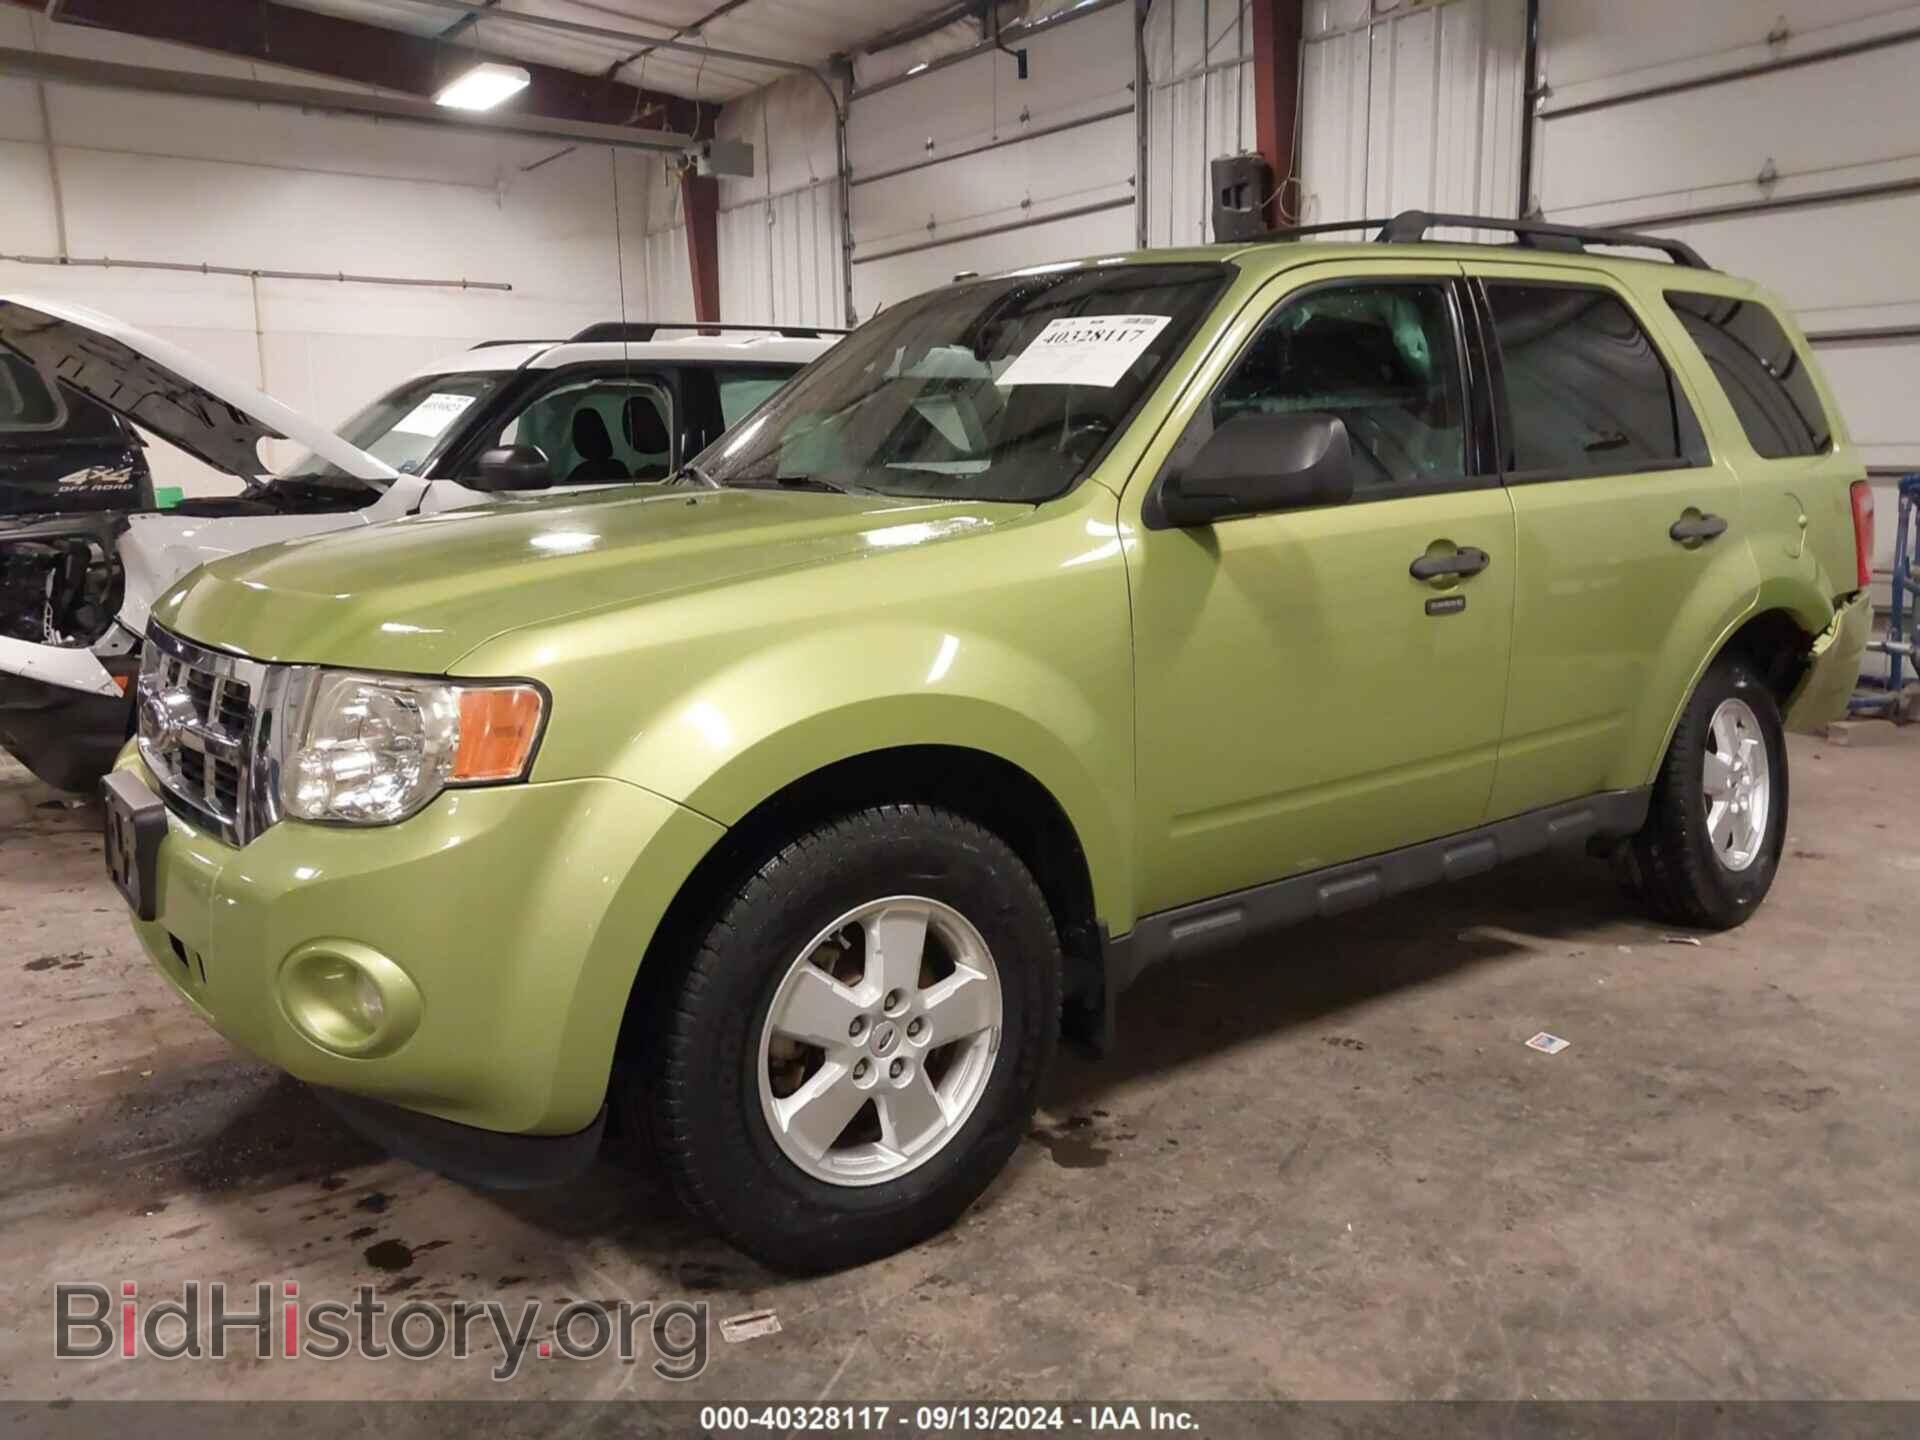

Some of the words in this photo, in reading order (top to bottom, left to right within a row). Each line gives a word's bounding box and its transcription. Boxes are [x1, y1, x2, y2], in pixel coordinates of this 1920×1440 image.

[1043, 328, 1145, 344] 40328117
[58, 485, 89, 493] OFF
[91, 483, 134, 491] ROAD
